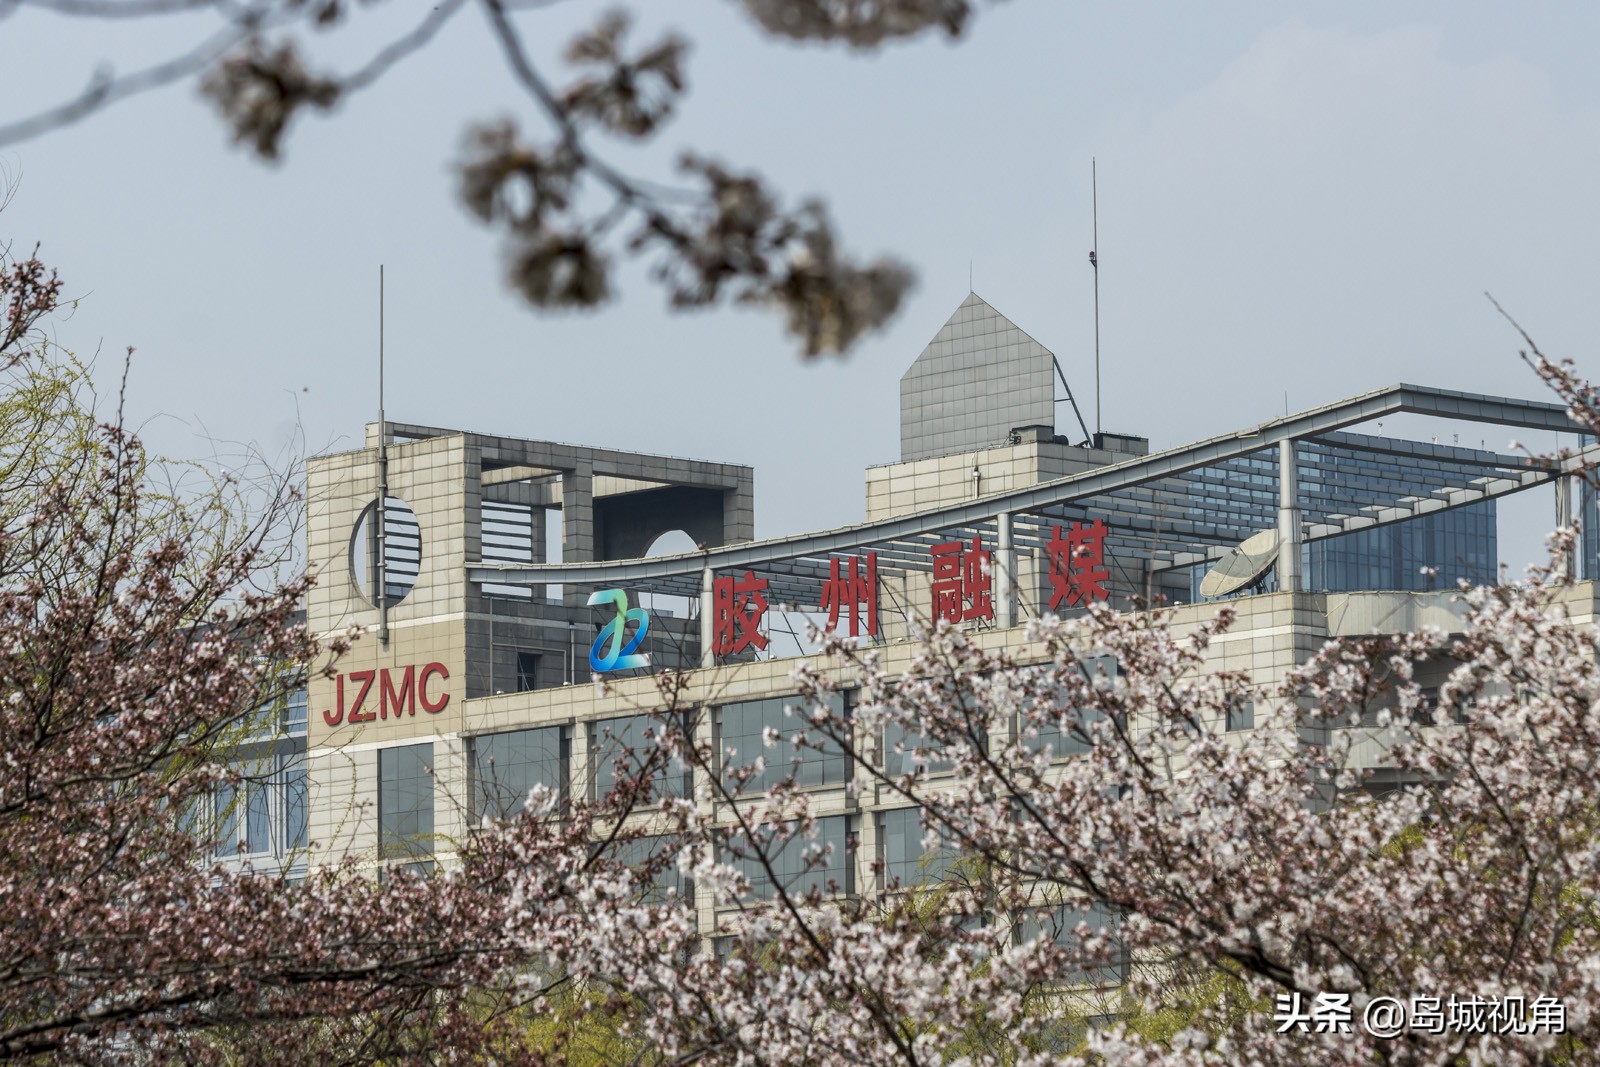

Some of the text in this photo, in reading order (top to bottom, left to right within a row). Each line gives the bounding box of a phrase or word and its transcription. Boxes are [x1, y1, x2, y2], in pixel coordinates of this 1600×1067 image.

[712, 518, 1110, 657] 胶州融媒
[323, 661, 450, 726] JZMC
